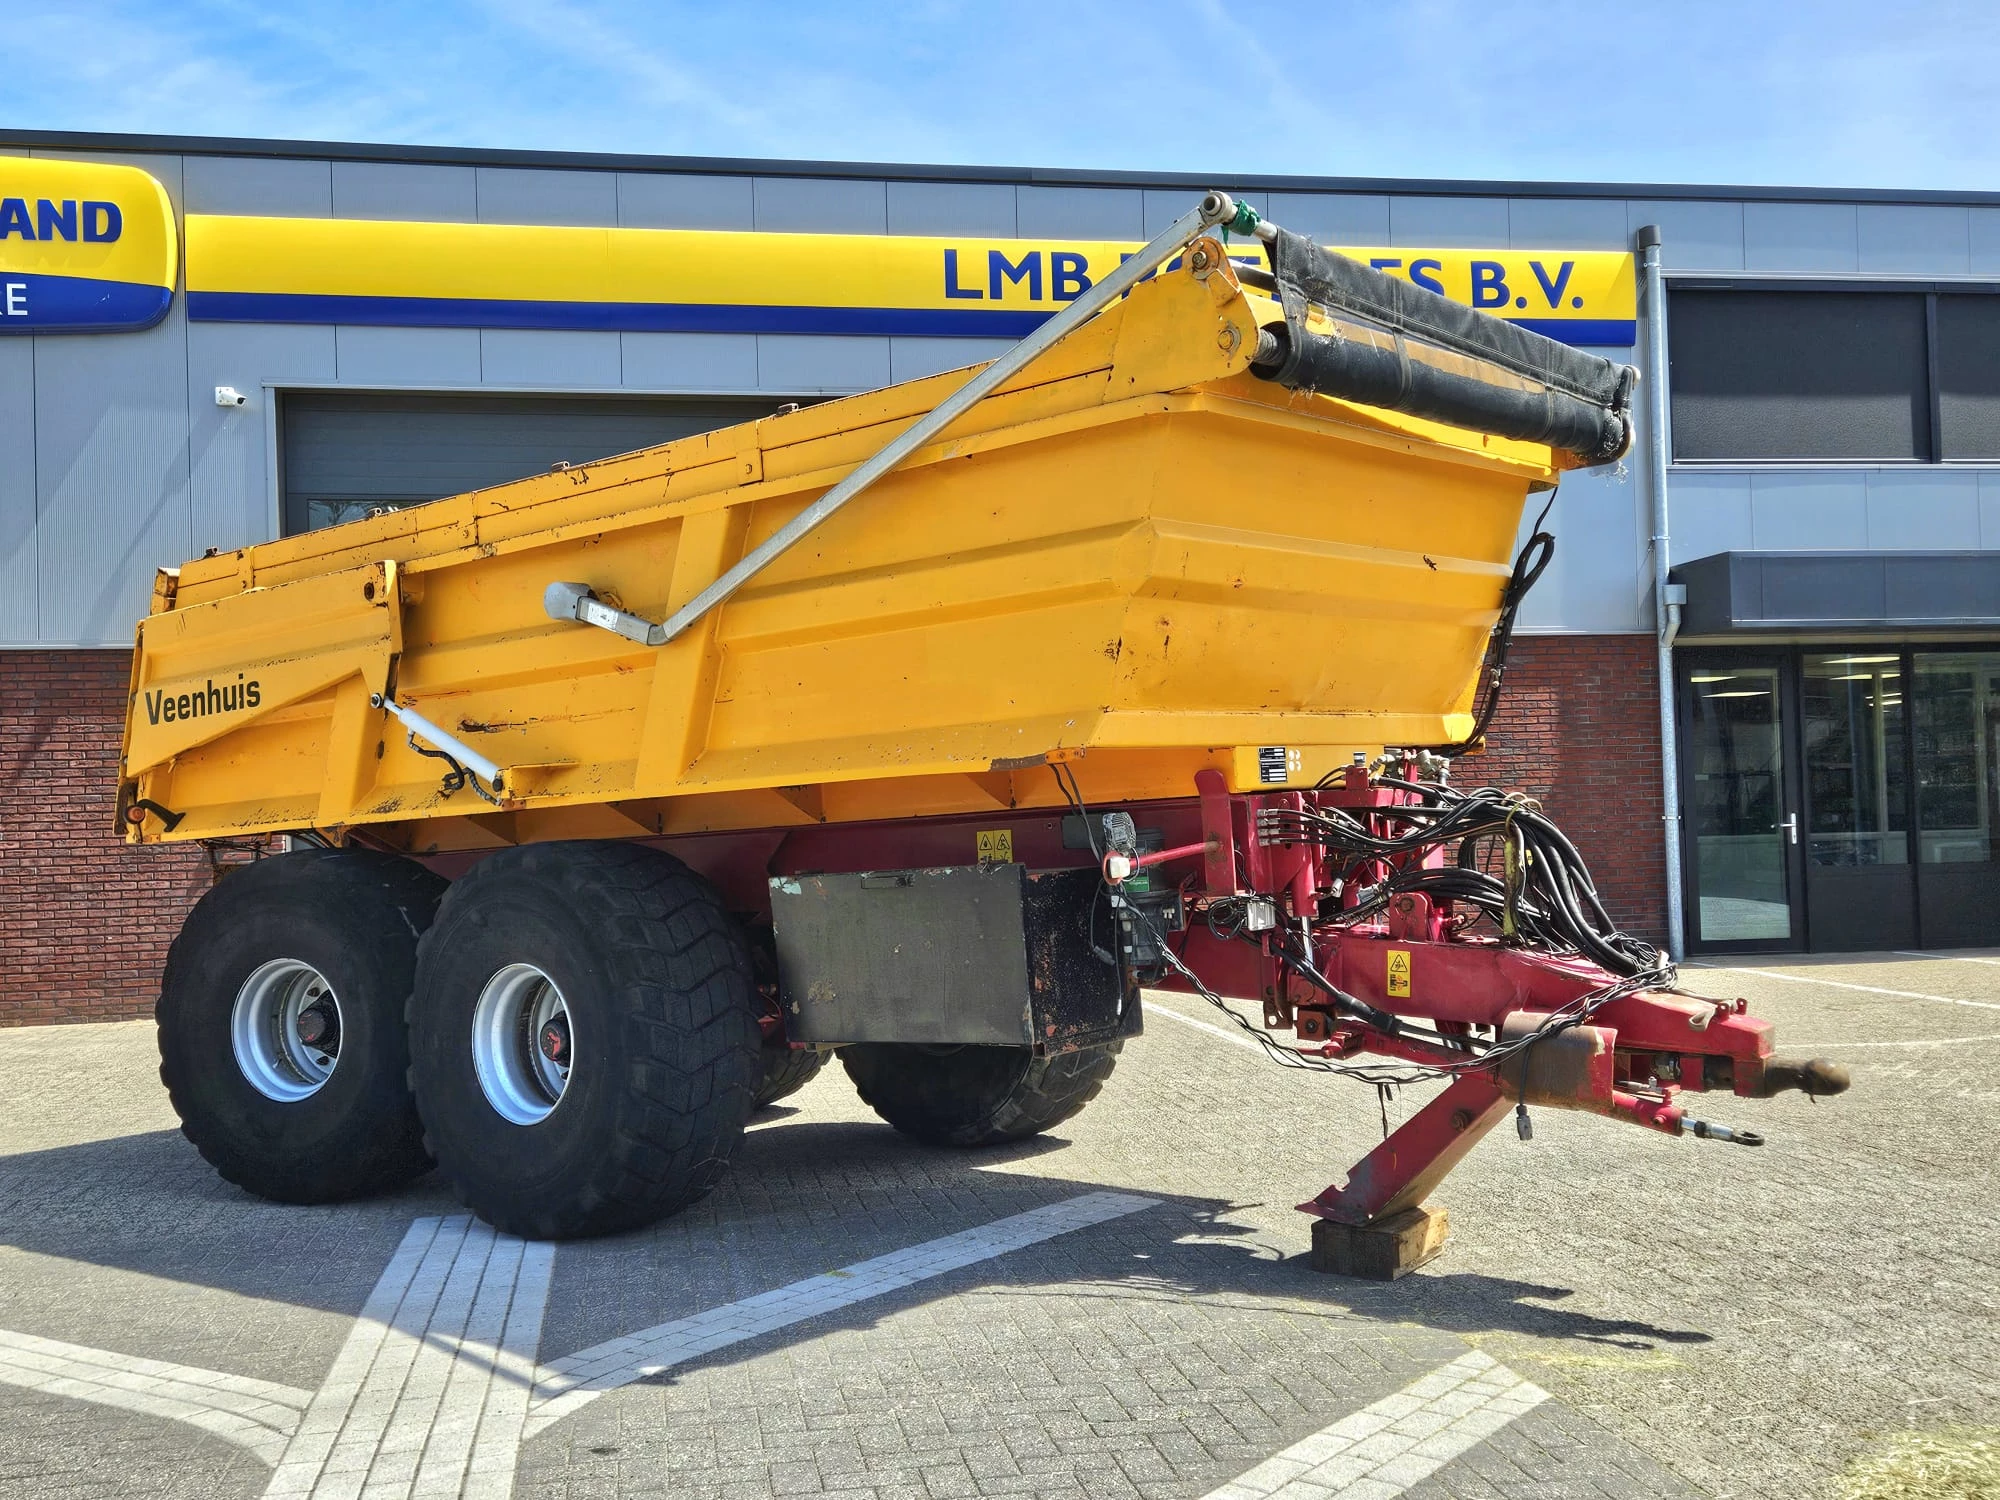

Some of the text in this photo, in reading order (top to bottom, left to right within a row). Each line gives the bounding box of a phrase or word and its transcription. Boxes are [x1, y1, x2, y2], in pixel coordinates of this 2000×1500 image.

[0, 198, 123, 243] AND
[0, 283, 28, 315] E
[944, 248, 1093, 301] LMB
[1470, 260, 1584, 309] B.V.
[145, 673, 260, 725] Veenhuis
